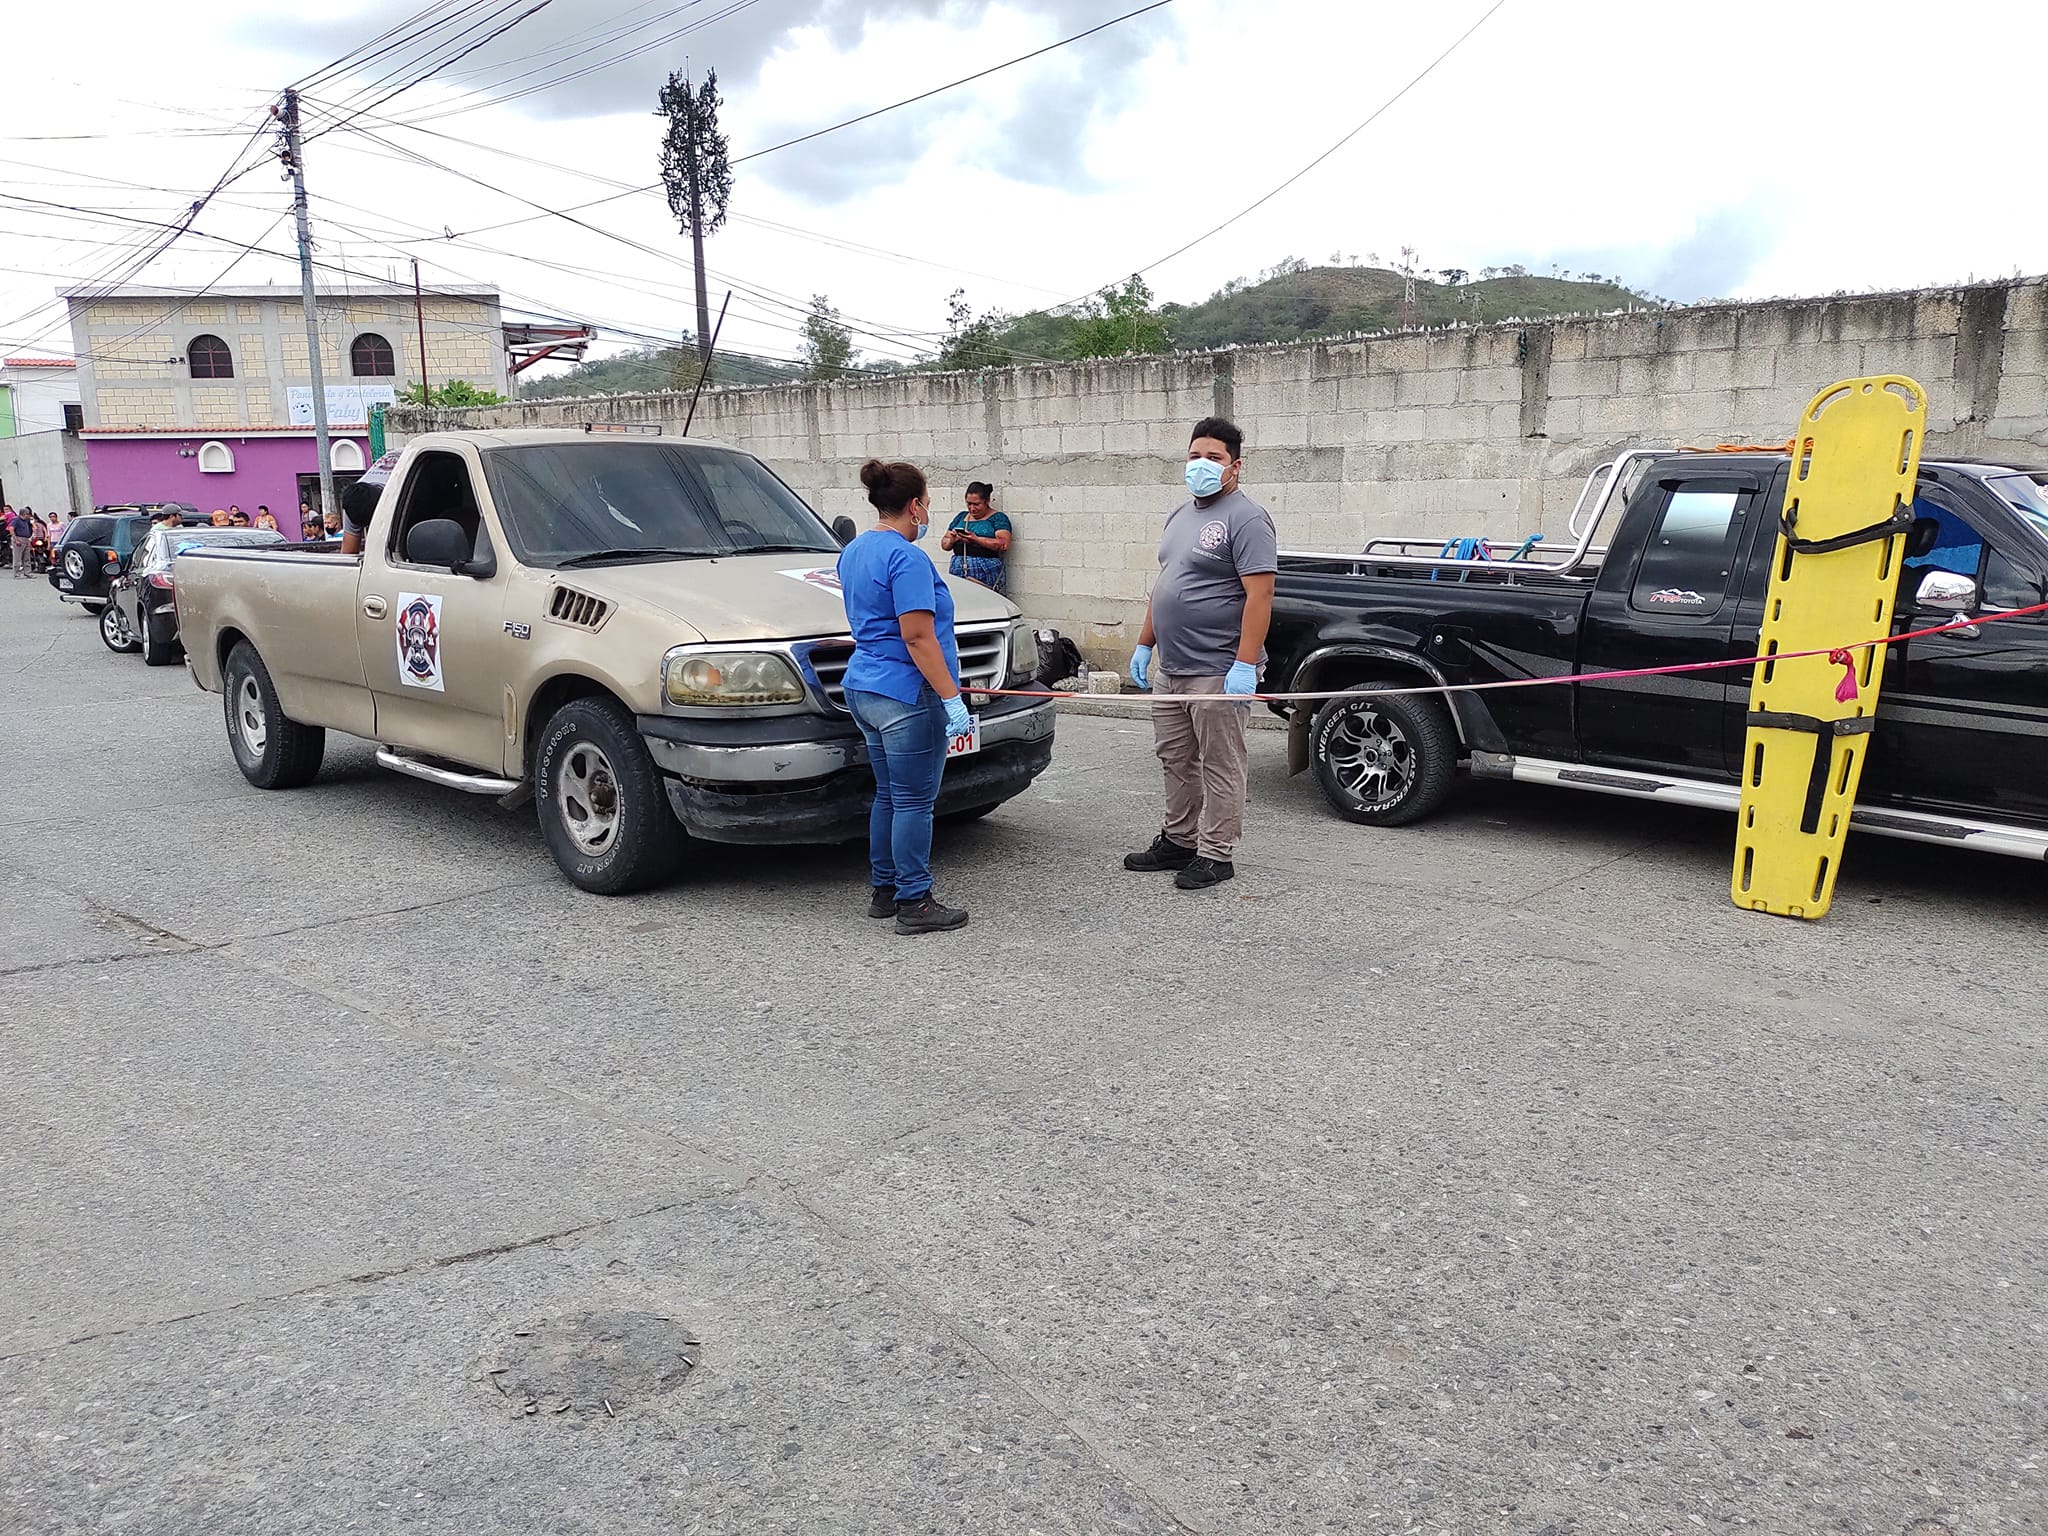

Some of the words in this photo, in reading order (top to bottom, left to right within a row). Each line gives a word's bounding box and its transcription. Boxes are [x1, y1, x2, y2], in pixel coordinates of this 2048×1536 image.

[1319, 707, 1348, 762] AVENGER
[1350, 702, 1374, 711] G/T
[1353, 747, 1417, 812] MASTERCRAFT
